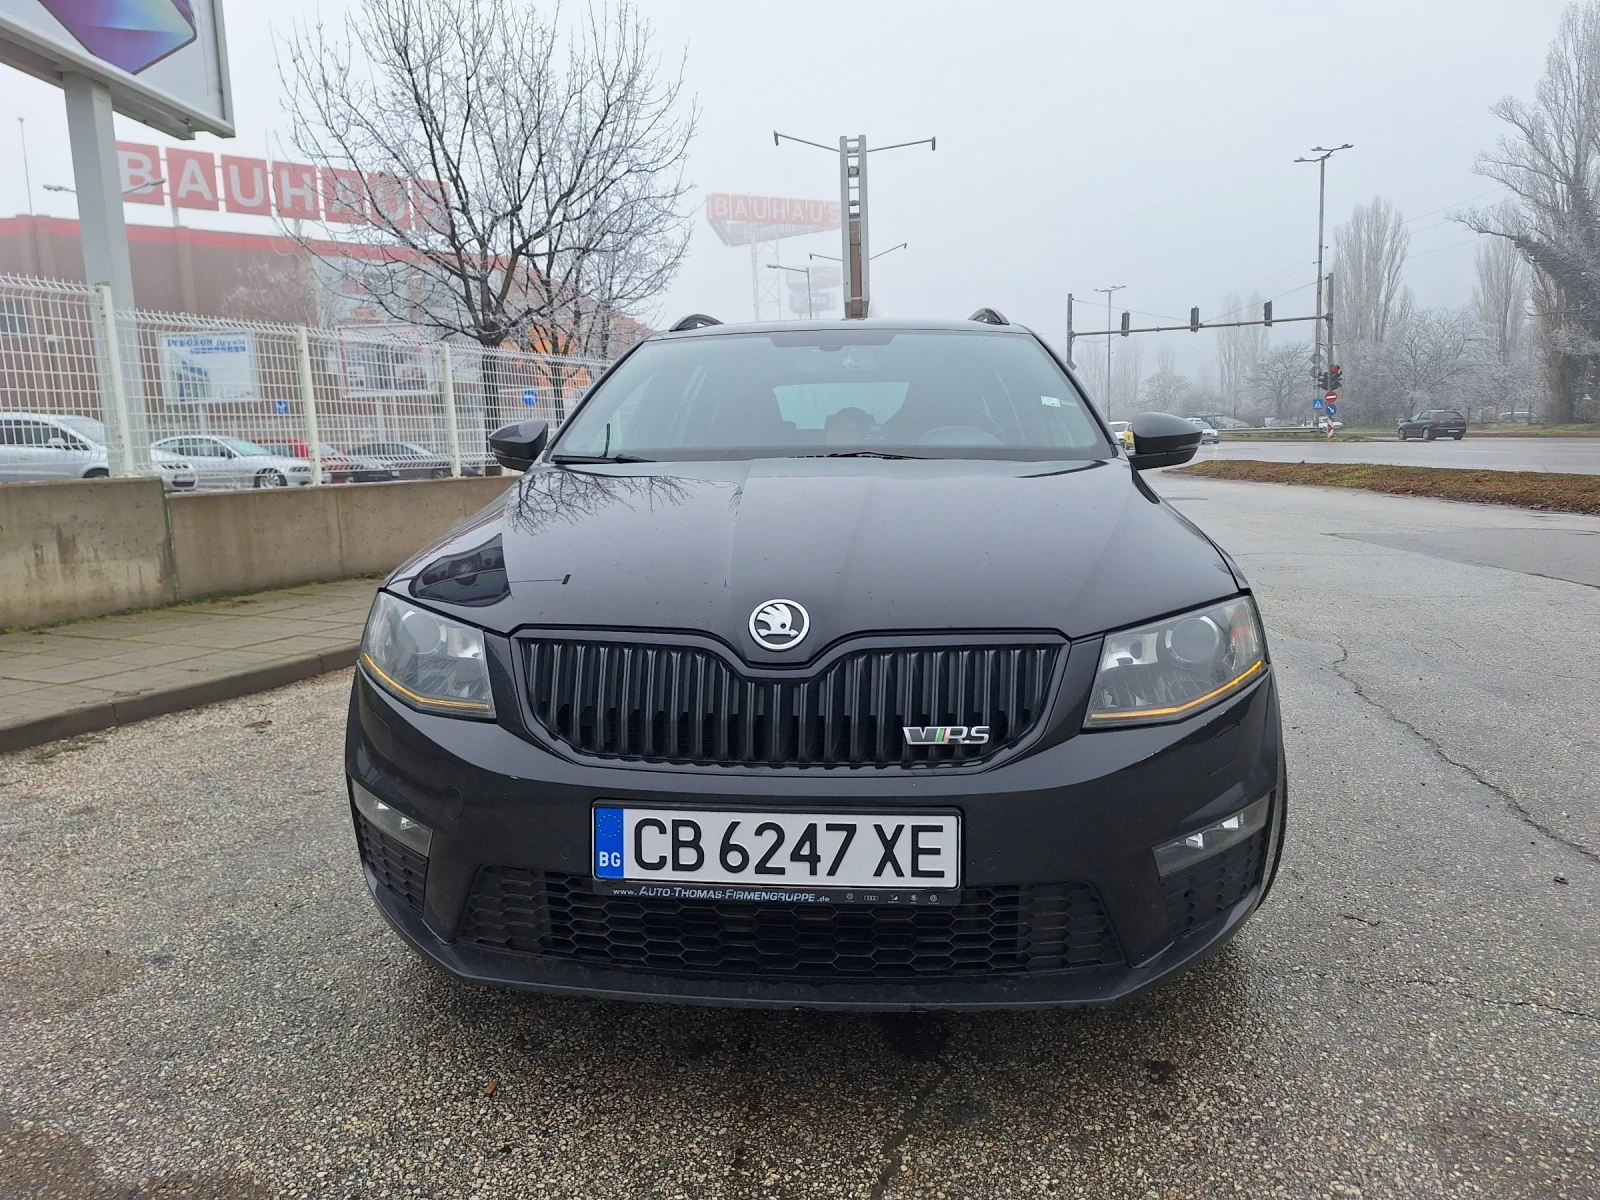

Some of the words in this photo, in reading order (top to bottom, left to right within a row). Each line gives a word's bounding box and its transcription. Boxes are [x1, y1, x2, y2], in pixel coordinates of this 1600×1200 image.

[121, 151, 450, 226] BAUHAUS
[715, 197, 842, 223] BAUHAUS
[599, 851, 621, 867] BG
[634, 818, 705, 871] CB
[719, 820, 857, 876] 6247
[873, 823, 945, 878] XE
